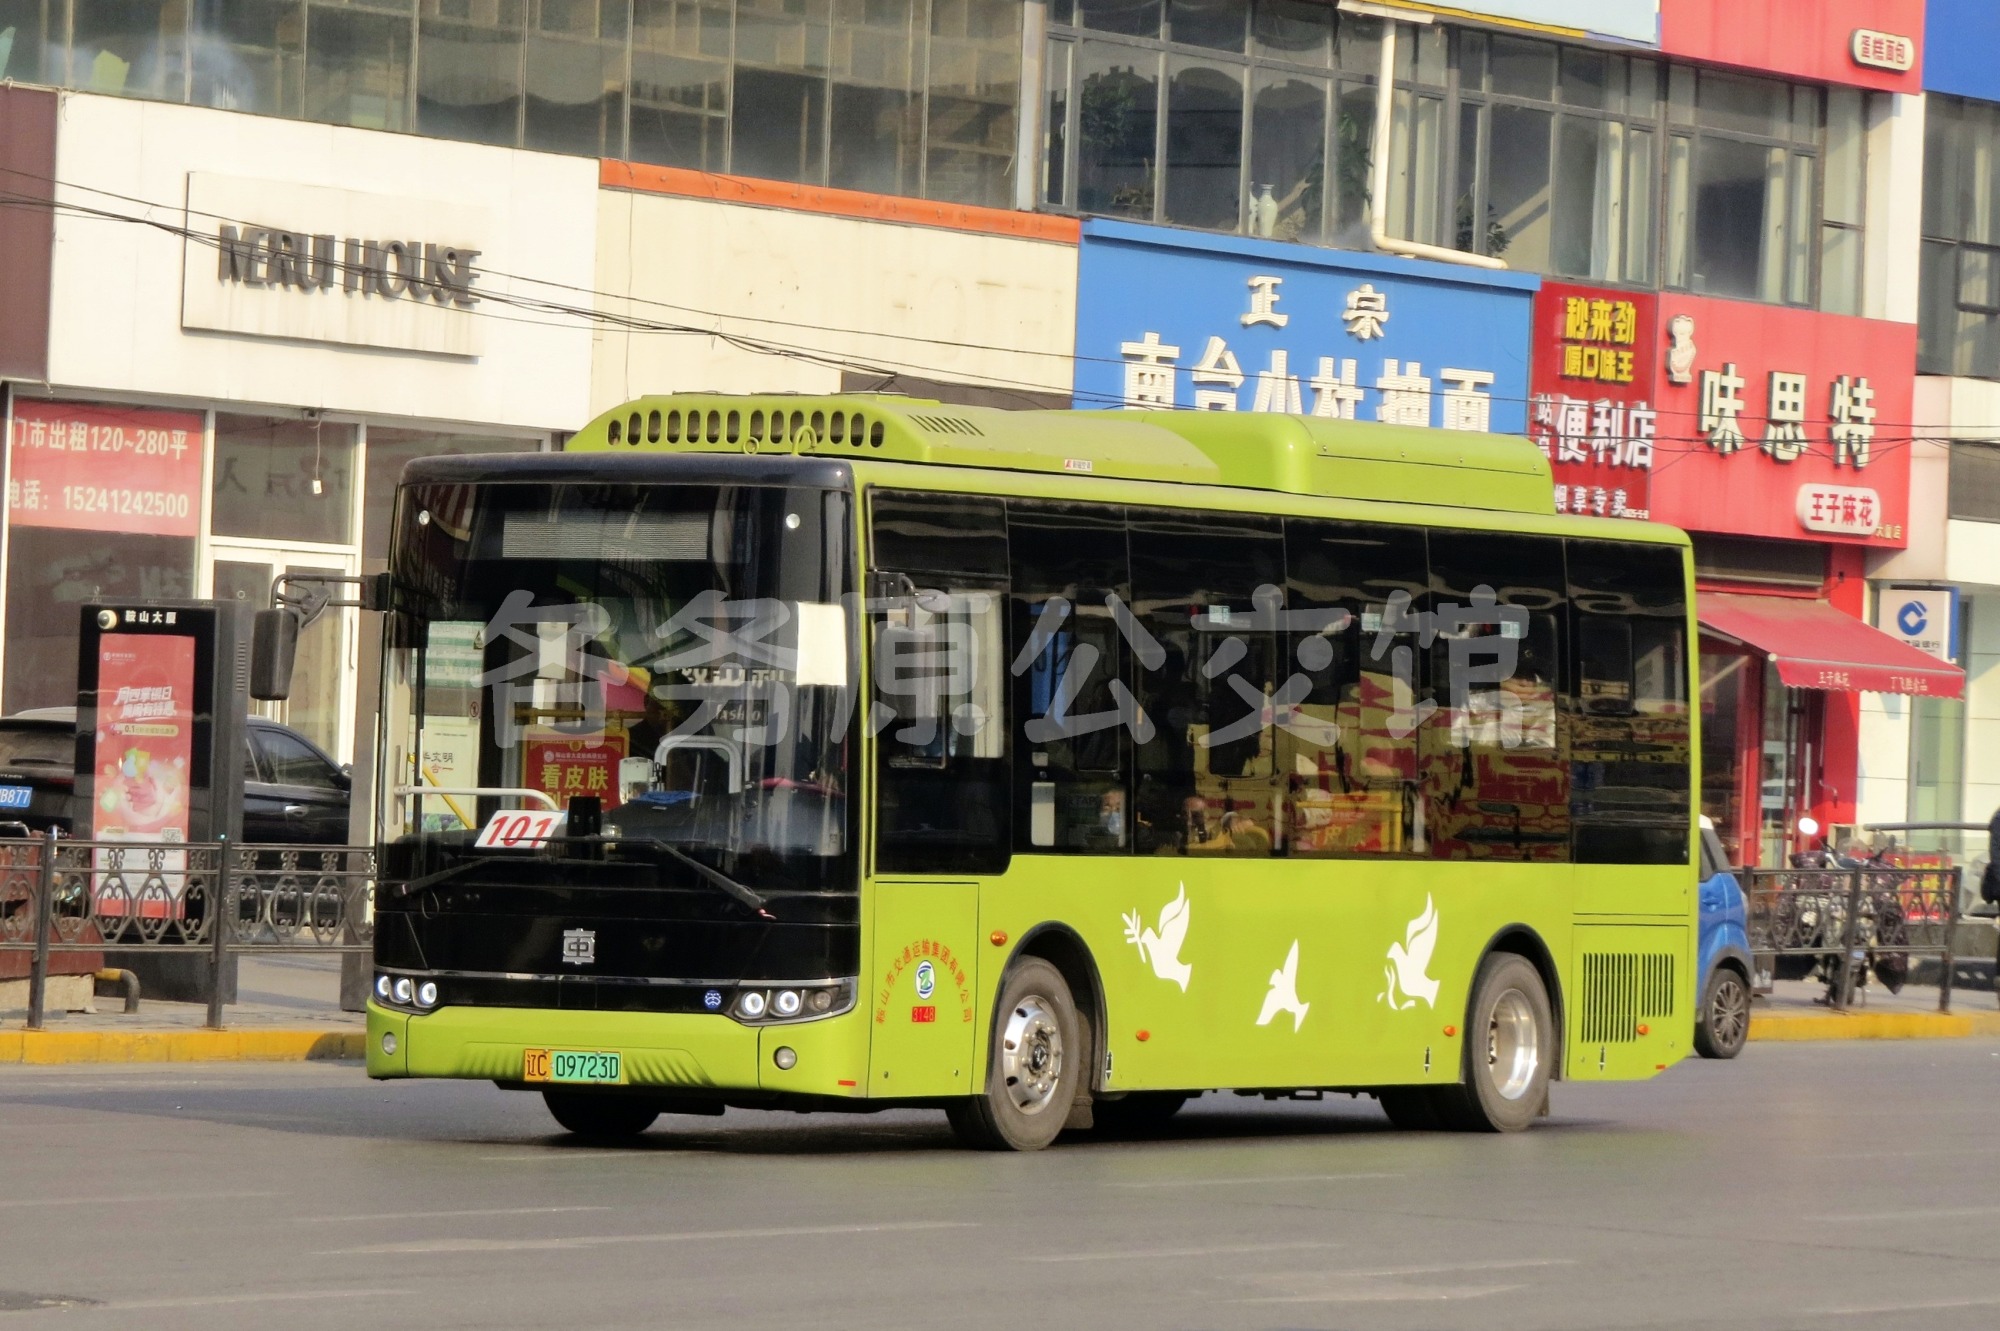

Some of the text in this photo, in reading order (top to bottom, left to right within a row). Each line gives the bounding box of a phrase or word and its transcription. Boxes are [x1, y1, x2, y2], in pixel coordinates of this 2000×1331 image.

[343, 238, 482, 304] HOUSE
[1240, 275, 1390, 340] 正宗
[1565, 297, 1636, 344] 秒来劲
[1556, 394, 1656, 468] 便利店
[1698, 363, 1876, 471] 味思特
[63, 486, 189, 518] 15241242500
[1810, 493, 1873, 527] 王子麻花
[125, 610, 177, 624] 鞍山大厦
[541, 764, 609, 790] 看皮肤
[0, 788, 31, 804] B877
[486, 815, 553, 848] 101
[913, 1007, 935, 1021] 3148
